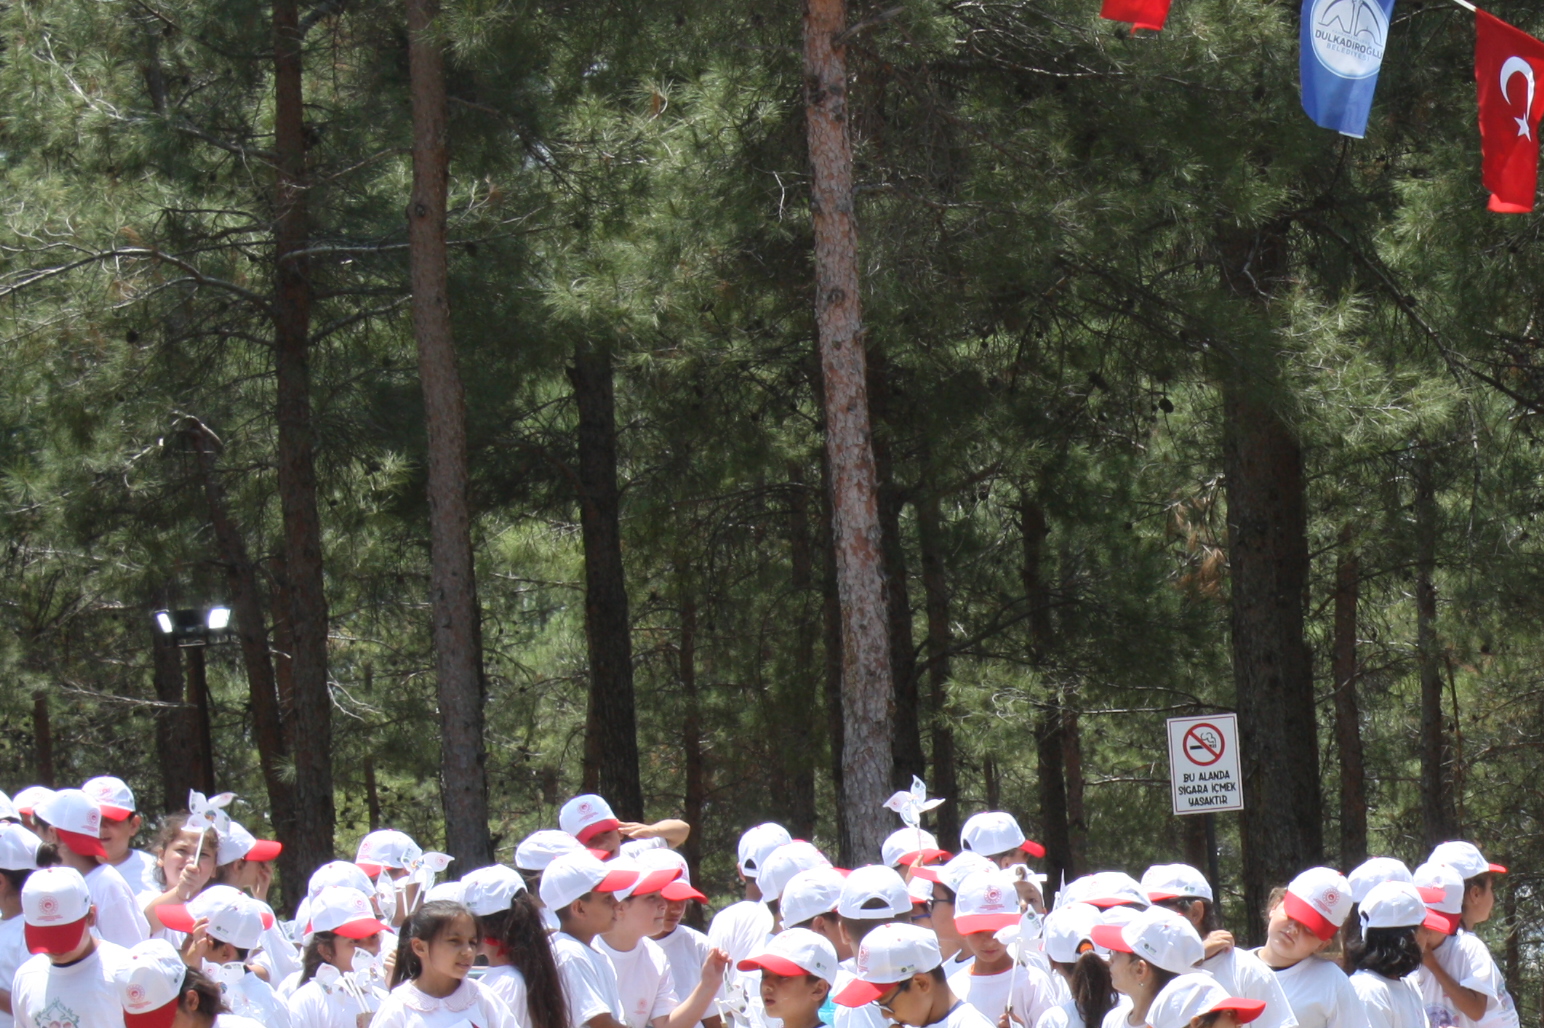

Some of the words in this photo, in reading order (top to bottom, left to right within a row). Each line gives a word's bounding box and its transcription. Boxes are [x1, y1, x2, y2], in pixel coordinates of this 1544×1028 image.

[1183, 773, 1195, 783] BU
[1199, 770, 1230, 781] ALANDA
[1178, 784, 1208, 796] SİGARA
[1211, 782, 1237, 794] İÇMEK
[1188, 795, 1228, 807] YASAKTIR
